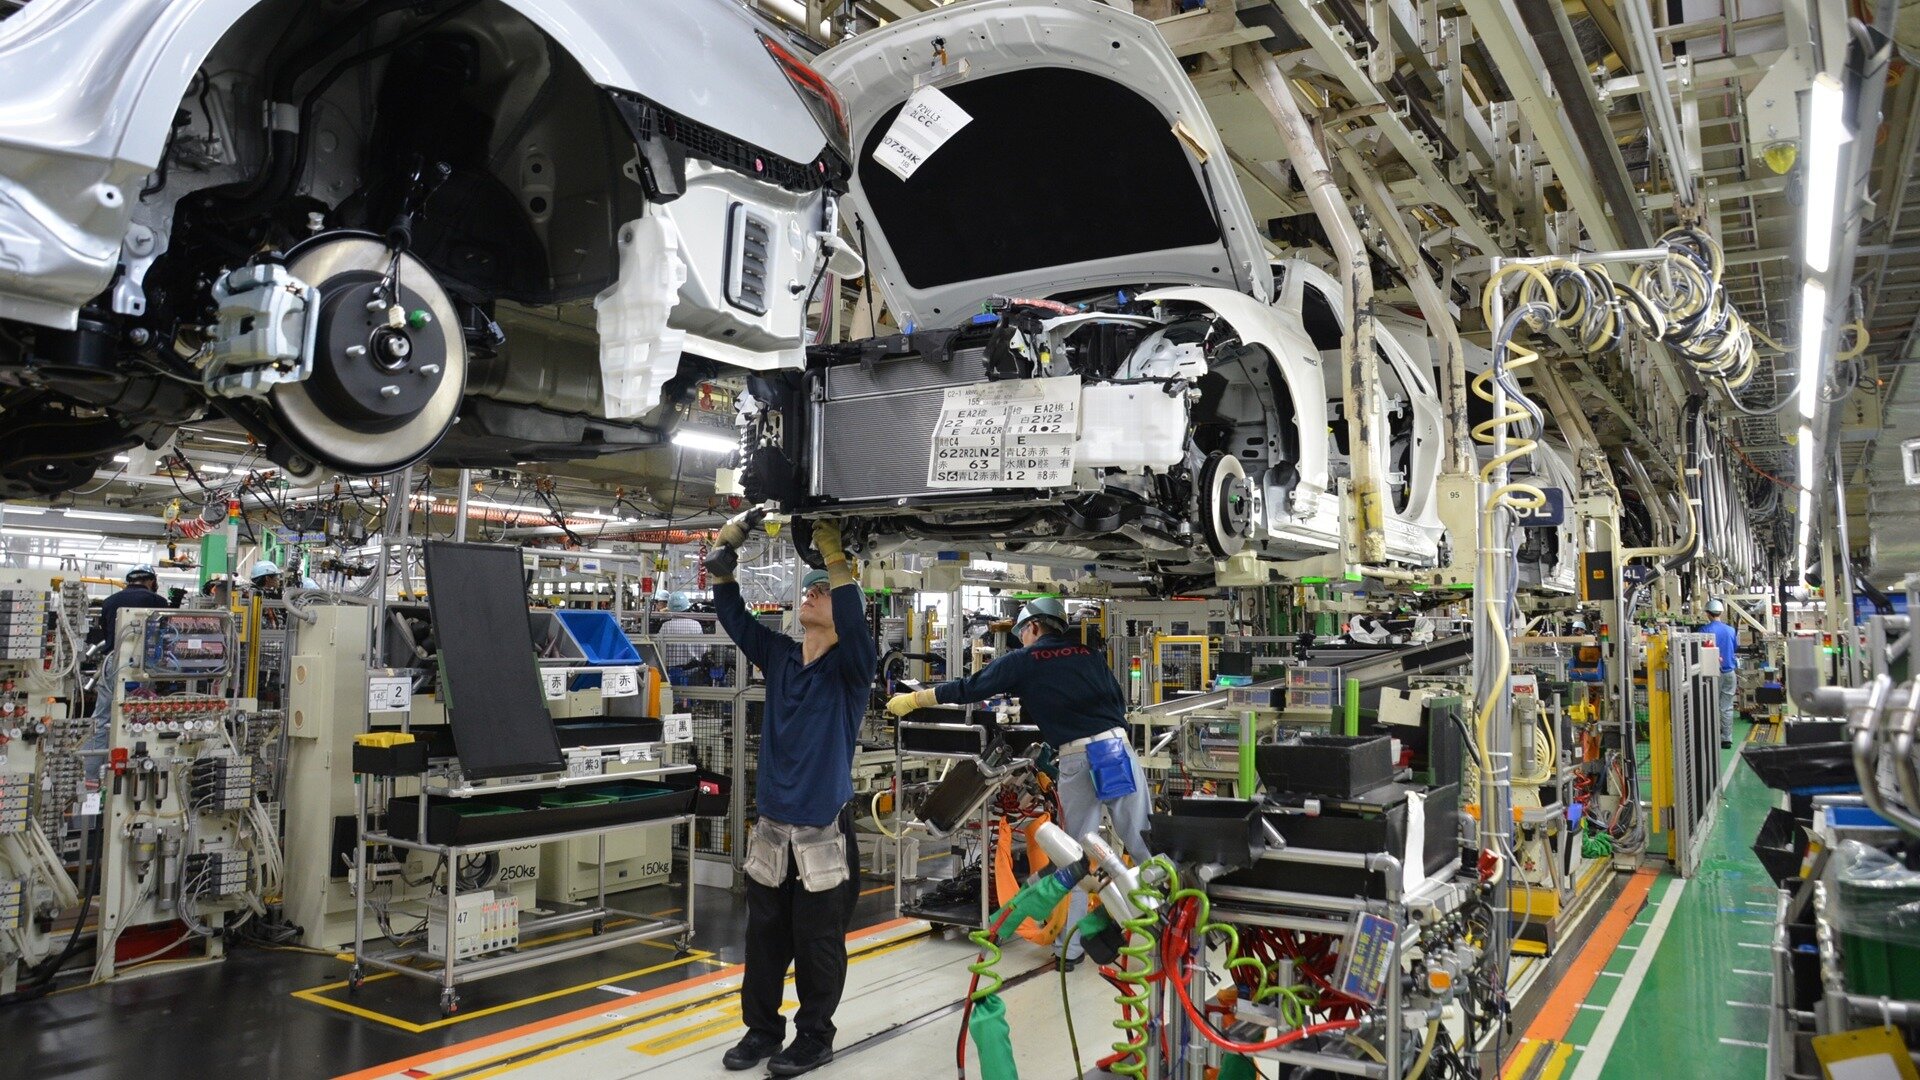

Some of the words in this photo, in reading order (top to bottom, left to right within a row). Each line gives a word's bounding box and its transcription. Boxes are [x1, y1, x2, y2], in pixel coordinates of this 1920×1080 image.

[1017, 436, 1026, 445] E
[969, 459, 989, 469] 63
[1449, 491, 1460, 499] 95
[1624, 569, 1641, 579] 4L
[1031, 646, 1091, 660] TOYOTA
[551, 676, 562, 689] 赤
[619, 674, 631, 687] 赤
[395, 685, 402, 698] 2
[678, 720, 688, 732] 黒
[500, 864, 537, 881] 250kg
[641, 861, 670, 877] 150kg
[457, 911, 468, 924] 47
